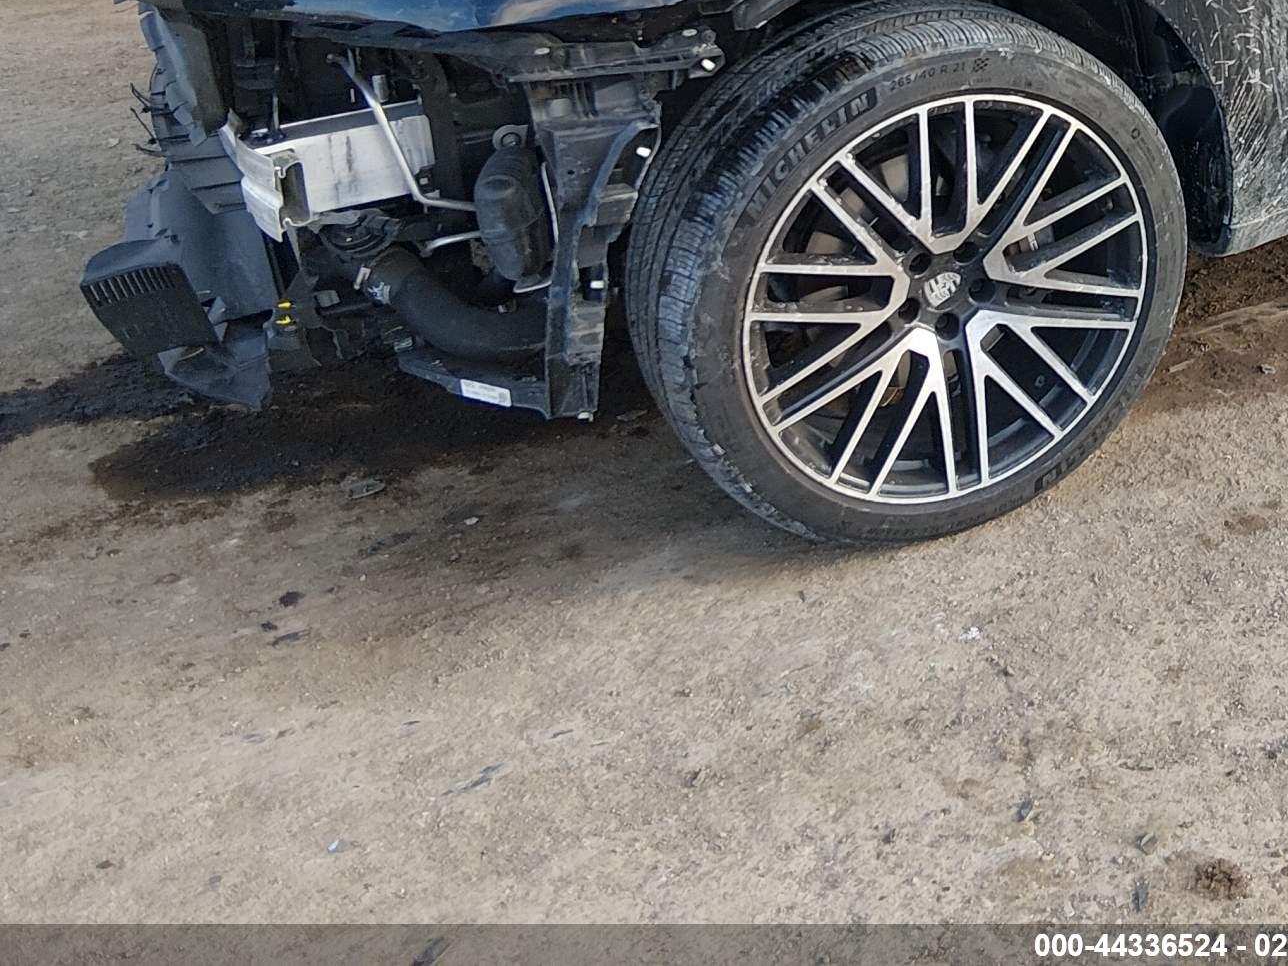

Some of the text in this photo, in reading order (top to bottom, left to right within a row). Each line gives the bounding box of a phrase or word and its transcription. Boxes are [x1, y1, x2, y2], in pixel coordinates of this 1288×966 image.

[890, 61, 967, 92] 265/40 R 21
[746, 92, 870, 220] MICHELIN
